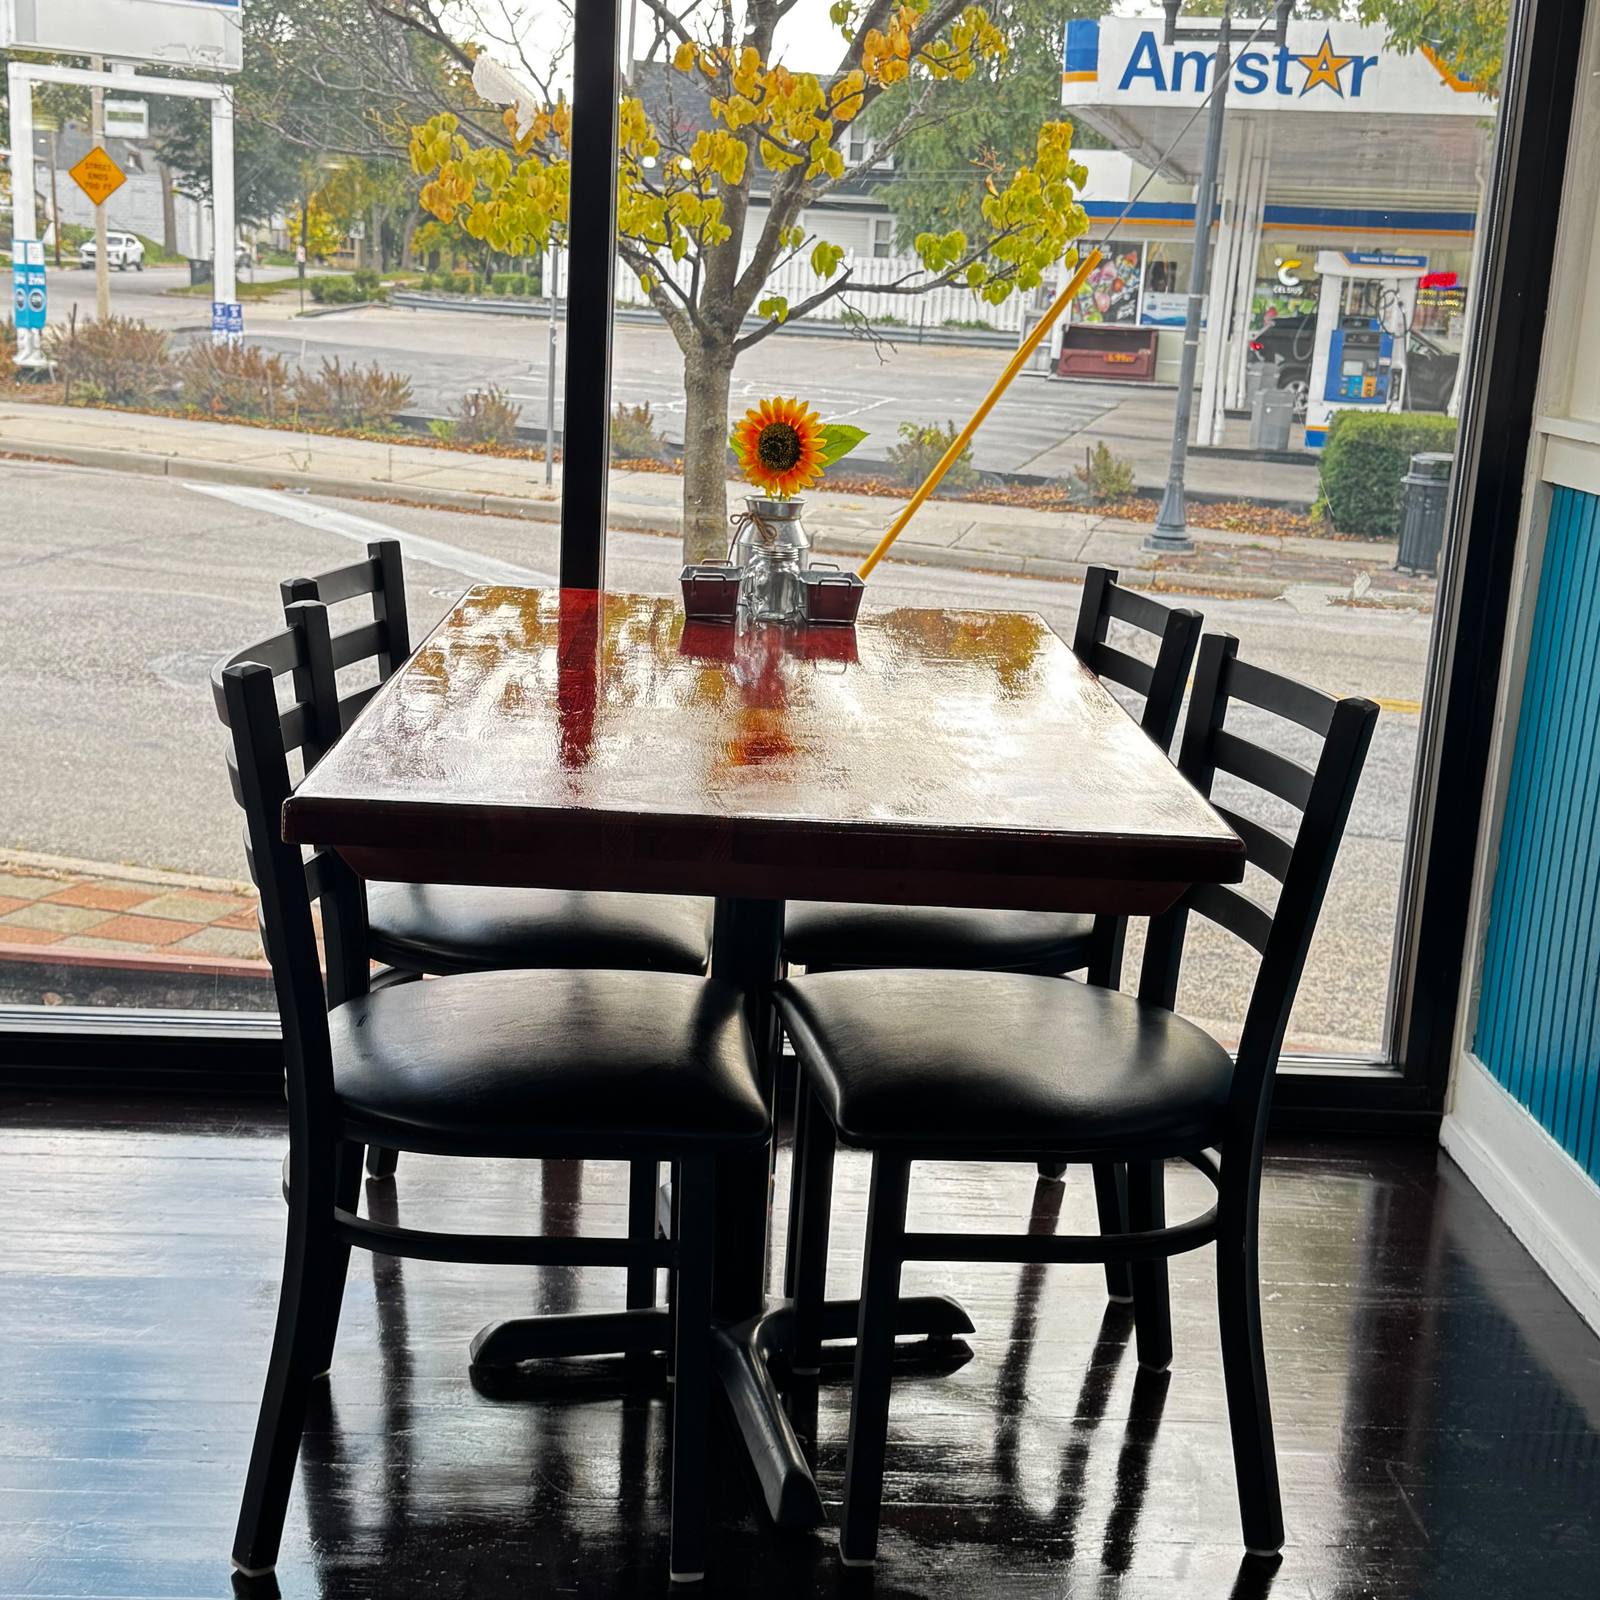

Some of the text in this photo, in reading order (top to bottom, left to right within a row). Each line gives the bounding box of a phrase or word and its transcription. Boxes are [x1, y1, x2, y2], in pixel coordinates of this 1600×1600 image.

[1118, 29, 1378, 99] Amstar
[85, 162, 111, 171] STREET
[1273, 285, 1305, 295] CELSIUS
